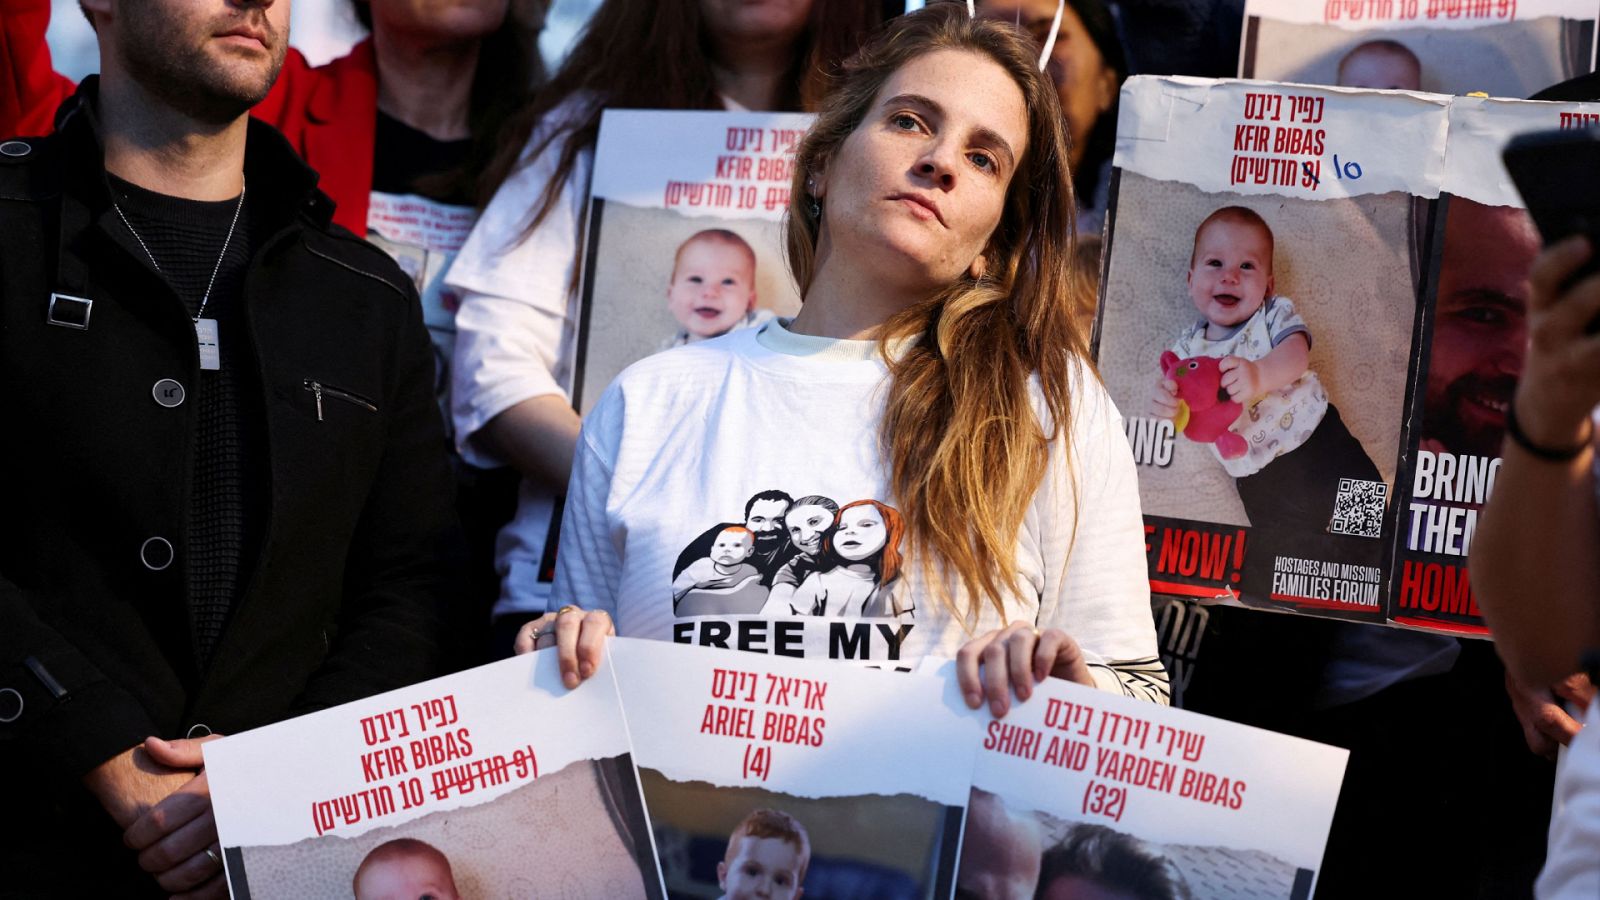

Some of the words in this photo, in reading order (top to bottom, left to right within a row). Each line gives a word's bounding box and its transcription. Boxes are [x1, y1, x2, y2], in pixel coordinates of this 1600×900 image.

[1244, 93, 1282, 120] ביבס
[1288, 95, 1325, 123] כפיר
[726, 126, 763, 152] ביבס
[1233, 124, 1271, 153] KFIR
[1273, 127, 1326, 156] BIBAS
[715, 155, 753, 180] KFIR
[1333, 154, 1363, 180] 10
[737, 185, 757, 209] 10
[1122, 416, 1176, 468] ING
[1156, 526, 1246, 583] NOW!
[1274, 555, 1320, 577] HOSTAGES
[1321, 561, 1340, 579] AND
[1341, 563, 1381, 583] MISSING
[1272, 572, 1331, 601] FAMILIES
[1333, 579, 1380, 606] FORUM
[1399, 560, 1484, 616] HOM
[829, 622, 915, 661] MY
[712, 668, 758, 703] ביבס
[766, 673, 828, 711] אריאל
[360, 708, 409, 747] ביבס
[411, 695, 459, 733] כפיר
[701, 704, 756, 740] ARIEL
[762, 711, 826, 748] BIBAS
[1044, 698, 1094, 737] ביבס
[1097, 711, 1152, 749] וירדן
[361, 746, 409, 783] KFIR
[411, 728, 474, 770] BIBAS
[743, 744, 772, 781] (4)
[1156, 725, 1206, 763] שירי
[984, 721, 1043, 761] SHIRI
[1044, 736, 1090, 772] AND
[1096, 747, 1177, 794] YARDEN
[1179, 768, 1247, 811] BIBAS
[398, 777, 425, 810] 10
[1082, 780, 1127, 822] (32)
